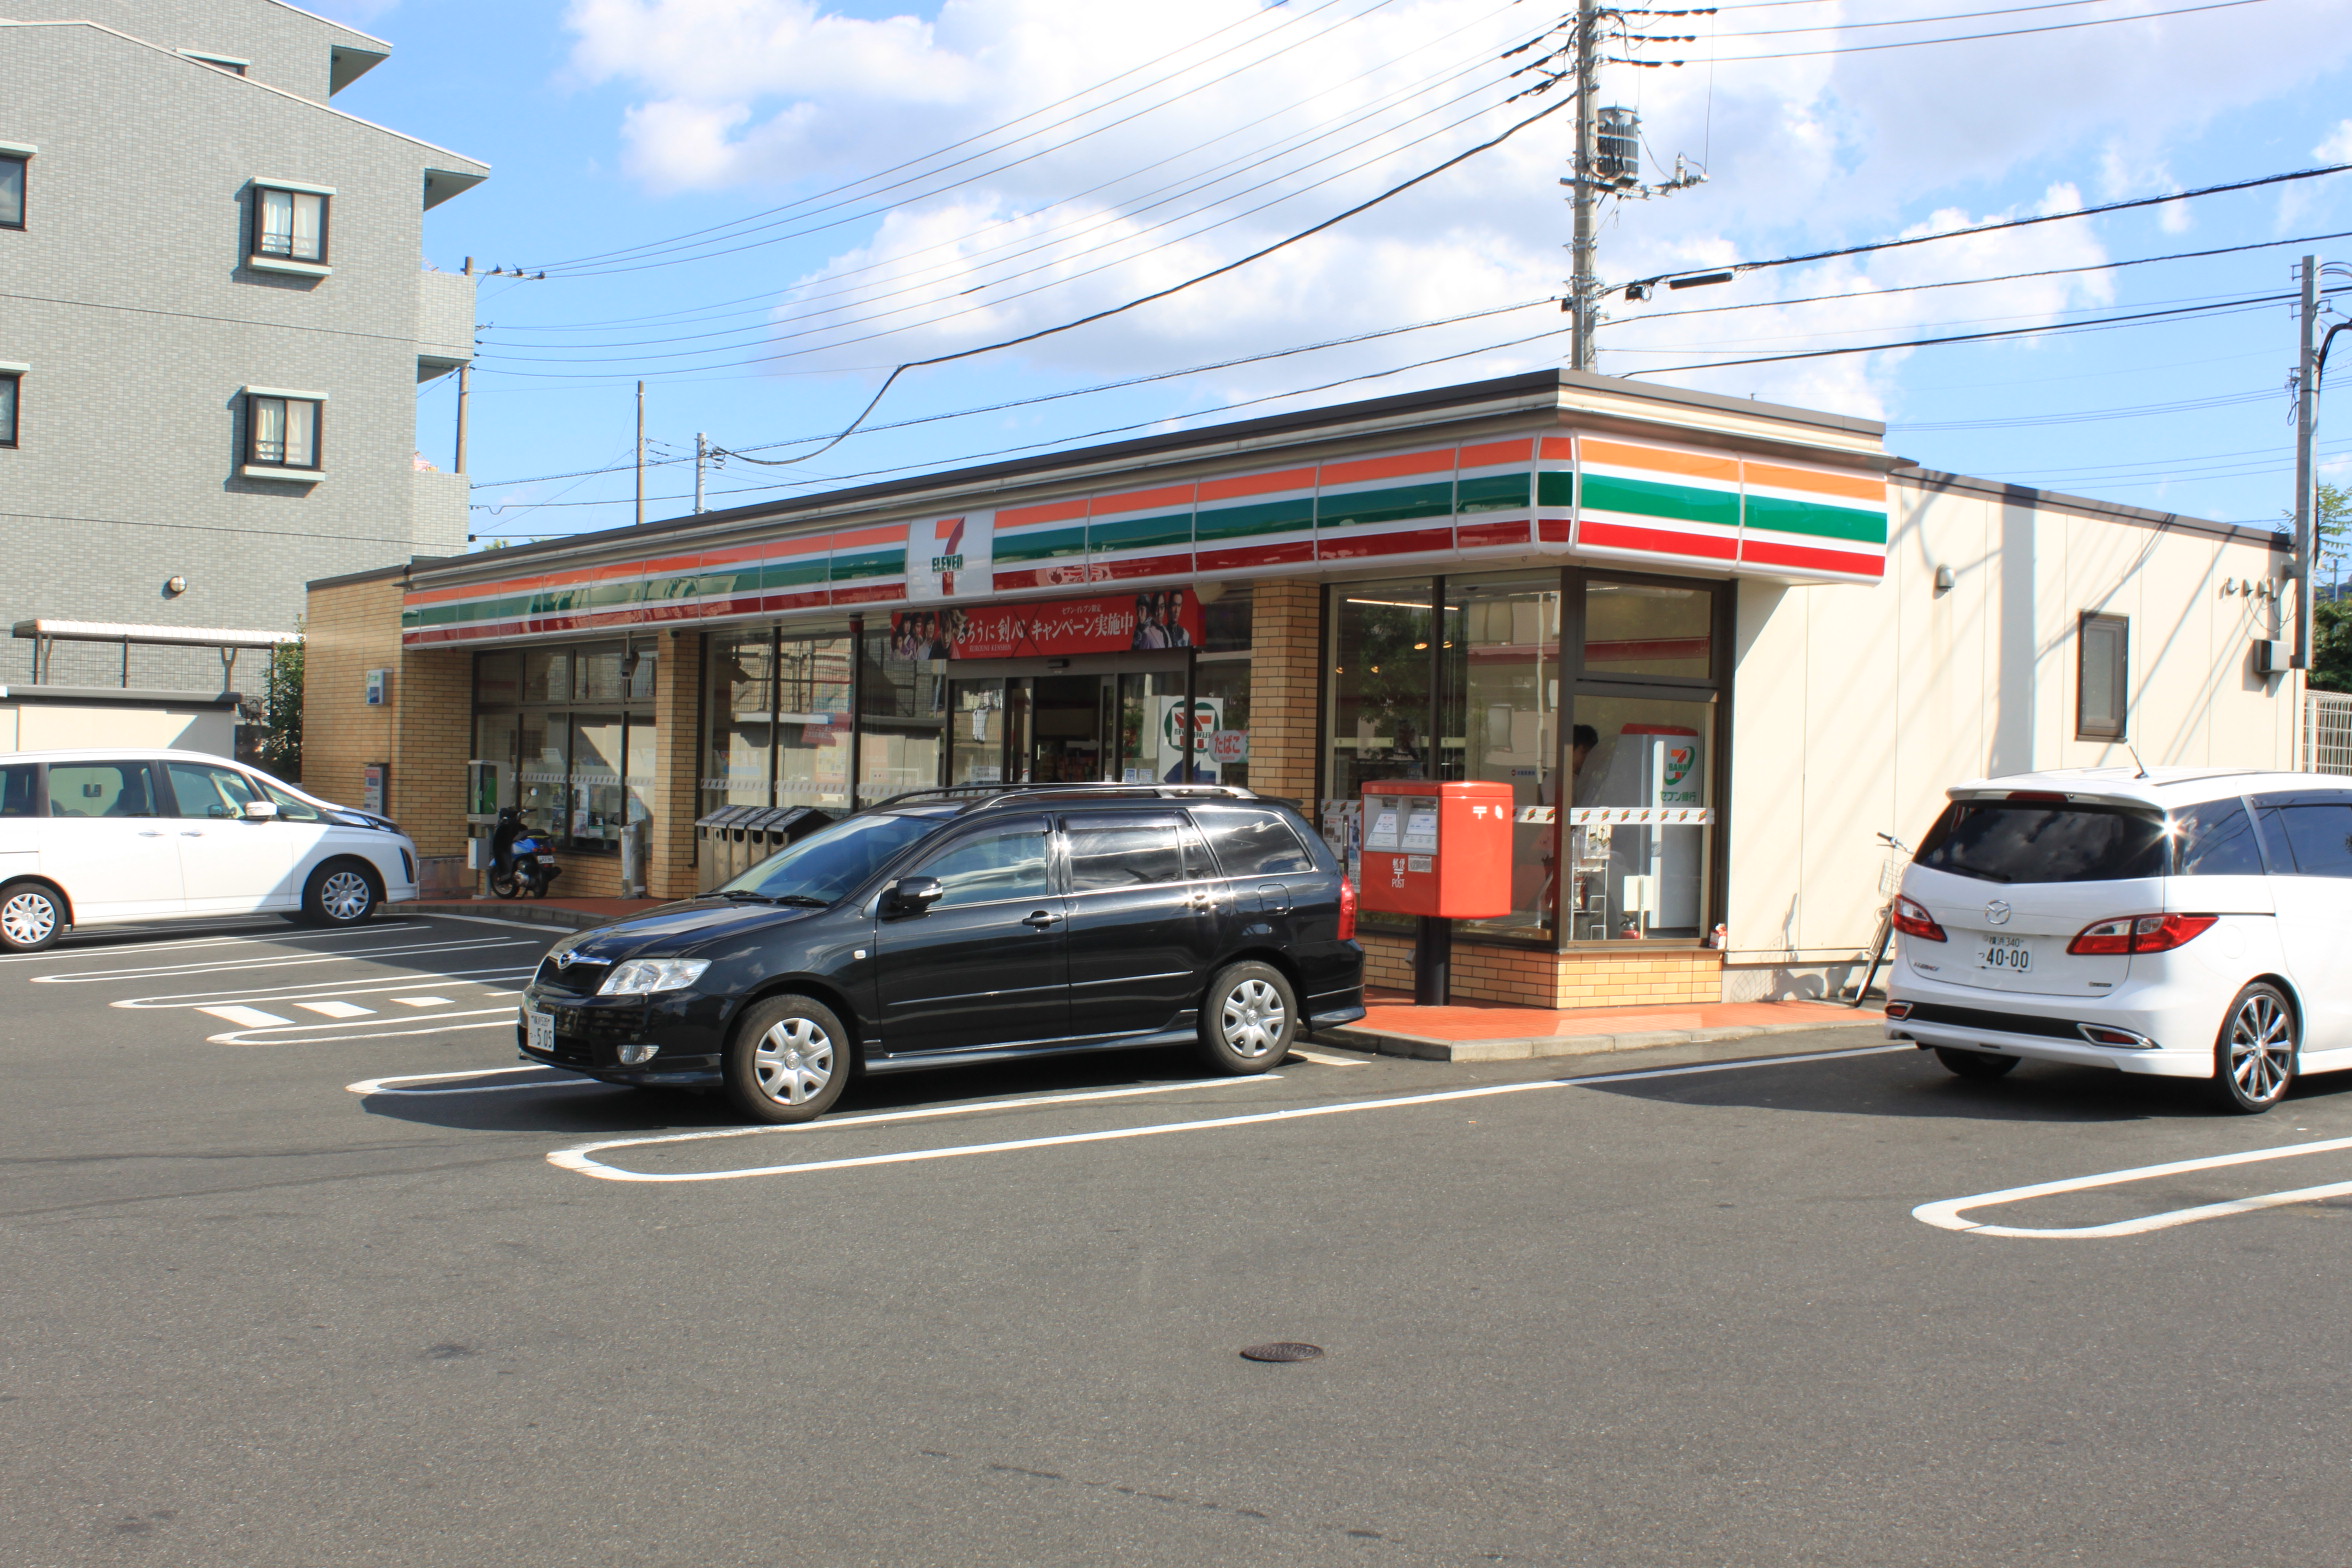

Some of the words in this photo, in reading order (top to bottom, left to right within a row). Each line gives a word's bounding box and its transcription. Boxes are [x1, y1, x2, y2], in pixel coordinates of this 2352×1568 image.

[956, 615, 1026, 645] るろうに剣心
[1031, 611, 1134, 641] キャンペーン実施中
[1215, 735, 1241, 755] たばこ
[1391, 878, 1405, 888] POST
[1986, 947, 2029, 968] 40-00
